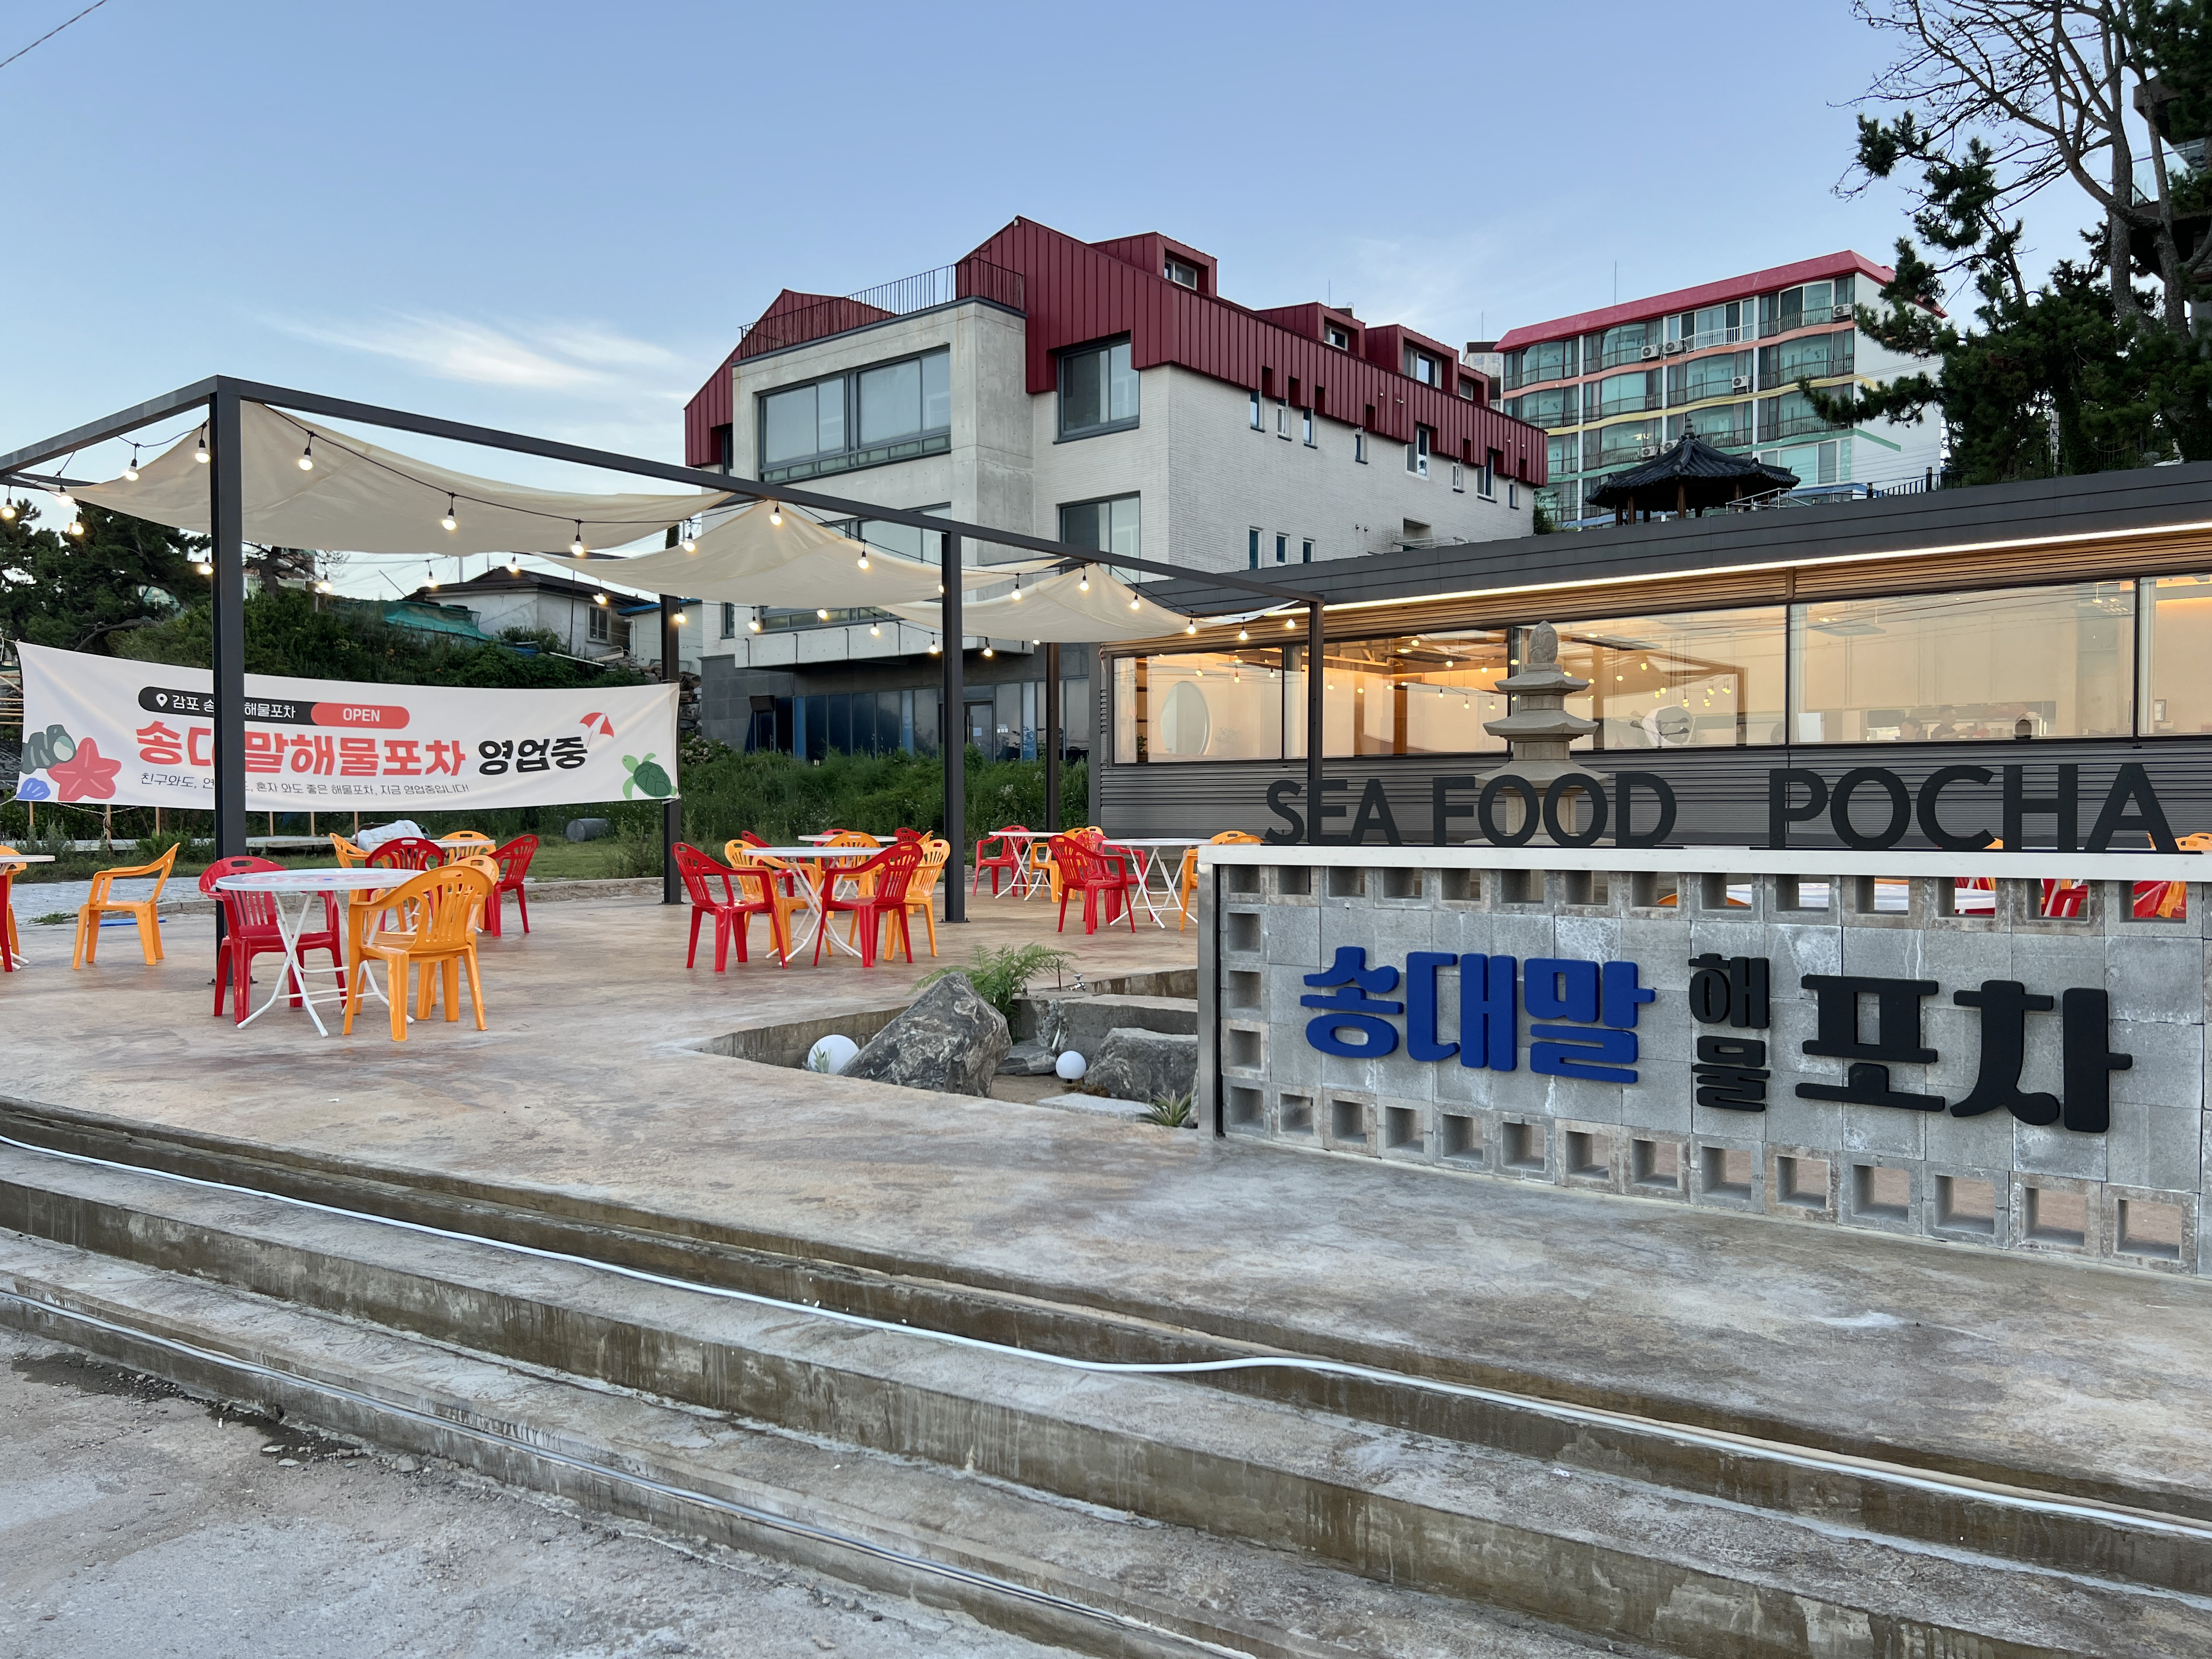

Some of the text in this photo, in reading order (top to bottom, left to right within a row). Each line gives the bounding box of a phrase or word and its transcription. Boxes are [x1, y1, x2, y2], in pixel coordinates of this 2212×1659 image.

[172, 695, 200, 711] 감포
[343, 708, 380, 722] OPEN
[478, 736, 588, 776] 영업중
[141, 772, 196, 789] 친구와도,
[256, 782, 278, 792] 혼자
[281, 783, 303, 793] 와도
[307, 784, 328, 794] 좋은
[331, 784, 377, 795] 해물포차,
[381, 785, 401, 795] 지금
[404, 784, 470, 795] 영업중입니다!
[1265, 763, 2180, 851] SEA FOOD POCHA
[1300, 946, 1656, 1084] 송대말
